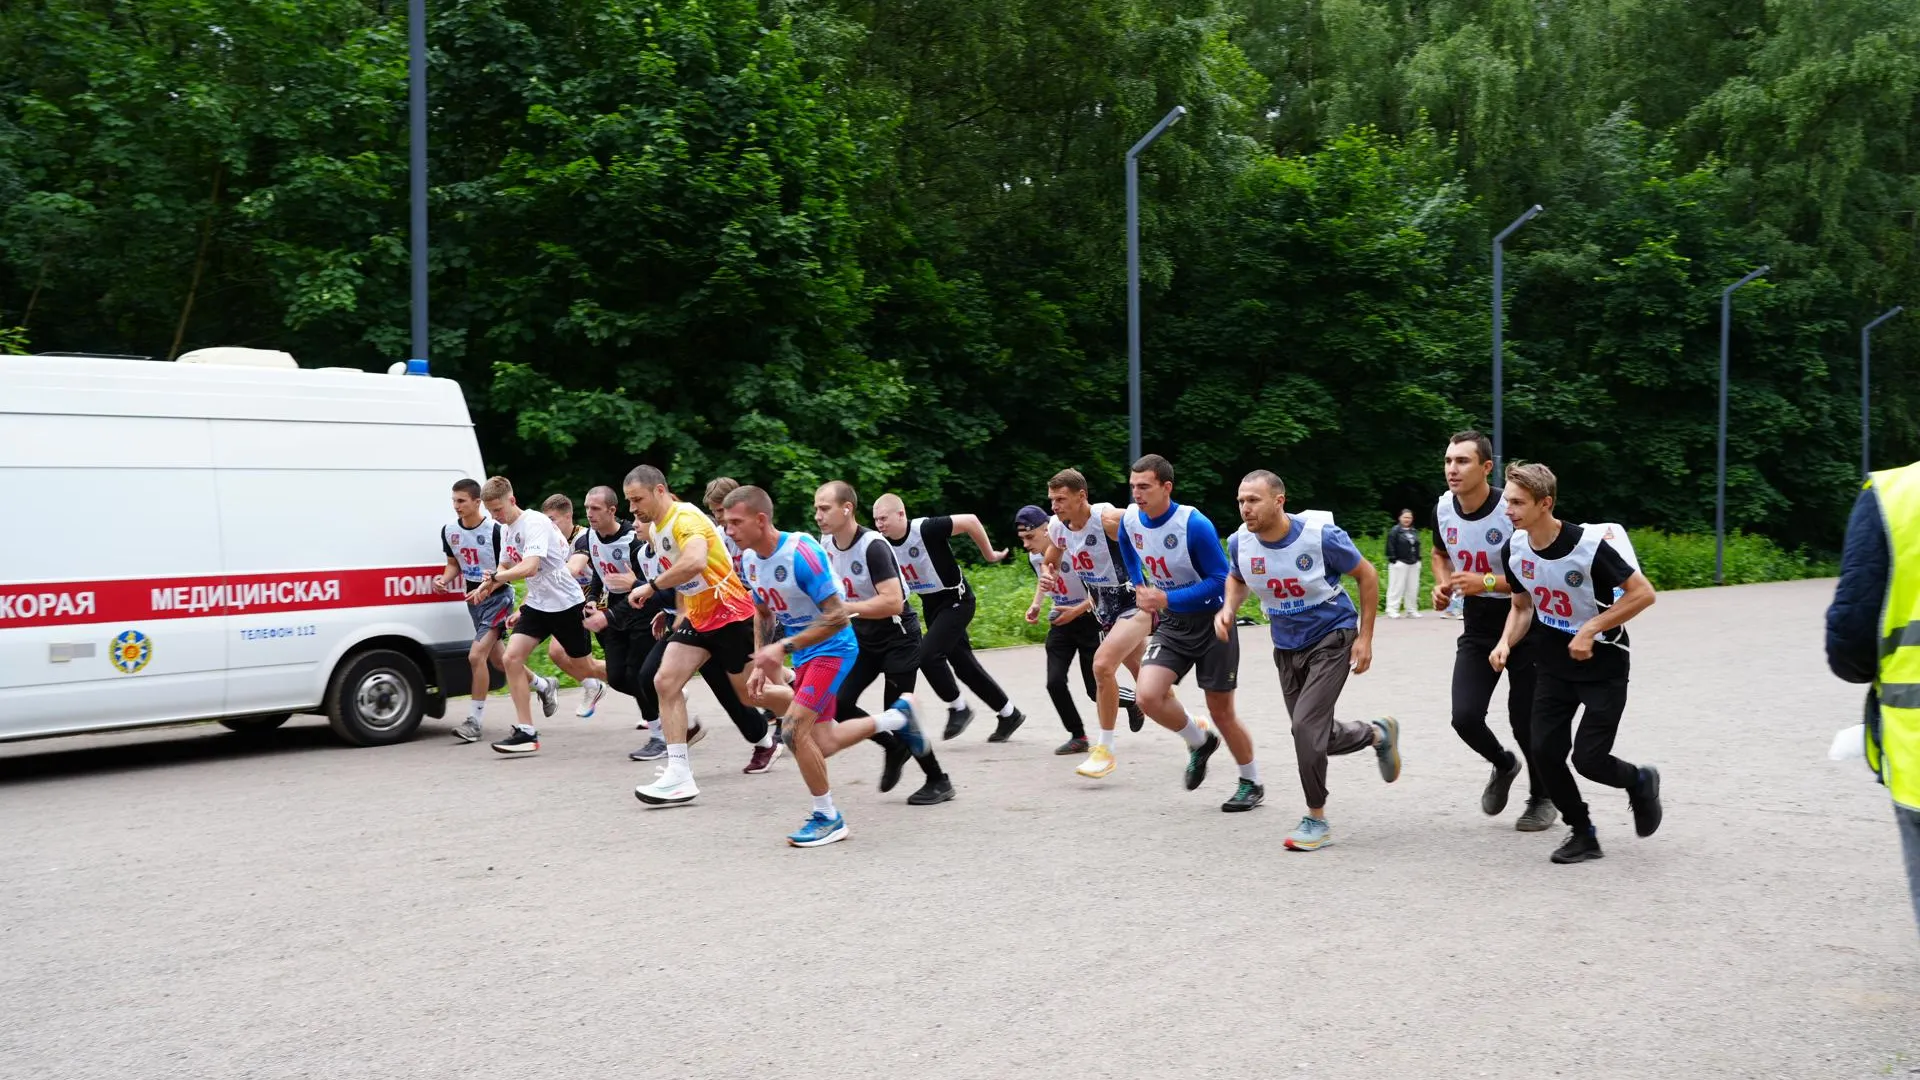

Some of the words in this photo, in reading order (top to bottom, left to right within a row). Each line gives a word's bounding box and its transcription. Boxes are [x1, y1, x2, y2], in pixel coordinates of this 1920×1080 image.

[1145, 556, 1172, 579] 21
[1458, 550, 1493, 574] 24
[151, 579, 340, 613] МЕДИЦИНСКАЯ
[1052, 576, 1068, 595] 8
[758, 587, 788, 611] 20
[1534, 586, 1573, 618] 23
[240, 627, 293, 641] ТЕЛЕФОН
[297, 624, 317, 637] 112
